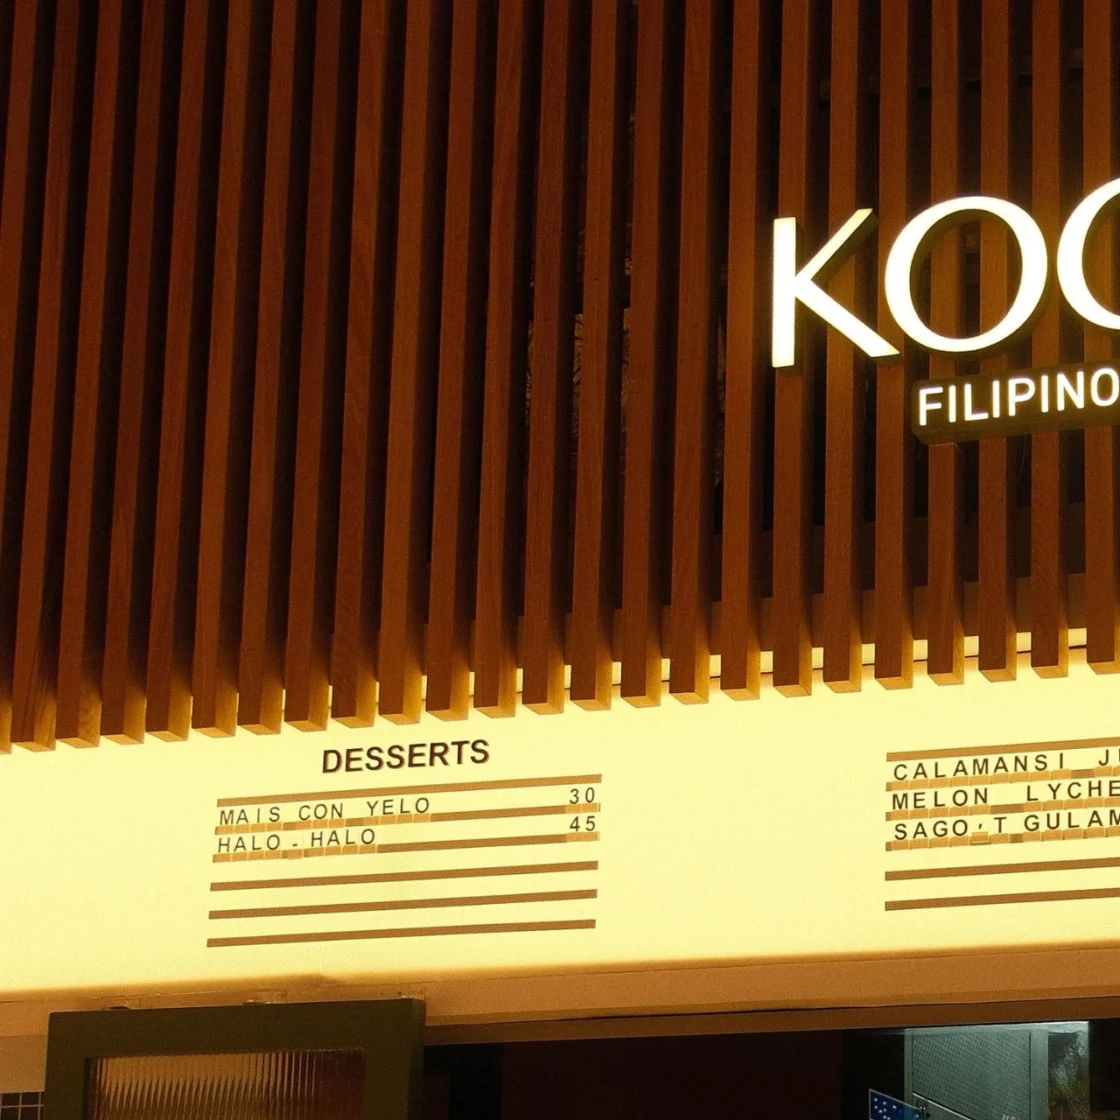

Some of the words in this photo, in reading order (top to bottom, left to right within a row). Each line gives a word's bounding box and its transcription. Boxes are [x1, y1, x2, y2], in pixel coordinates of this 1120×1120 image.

[919, 367, 1120, 426] FILIPINO
[322, 739, 490, 774] DESSERTS
[892, 752, 1065, 781] CALAMANSI
[569, 787, 596, 806] 30
[892, 787, 989, 810] MELON
[218, 806, 281, 826] MAIS
[297, 803, 343, 822] CON
[366, 797, 430, 817] YELO
[569, 815, 597, 833] 45
